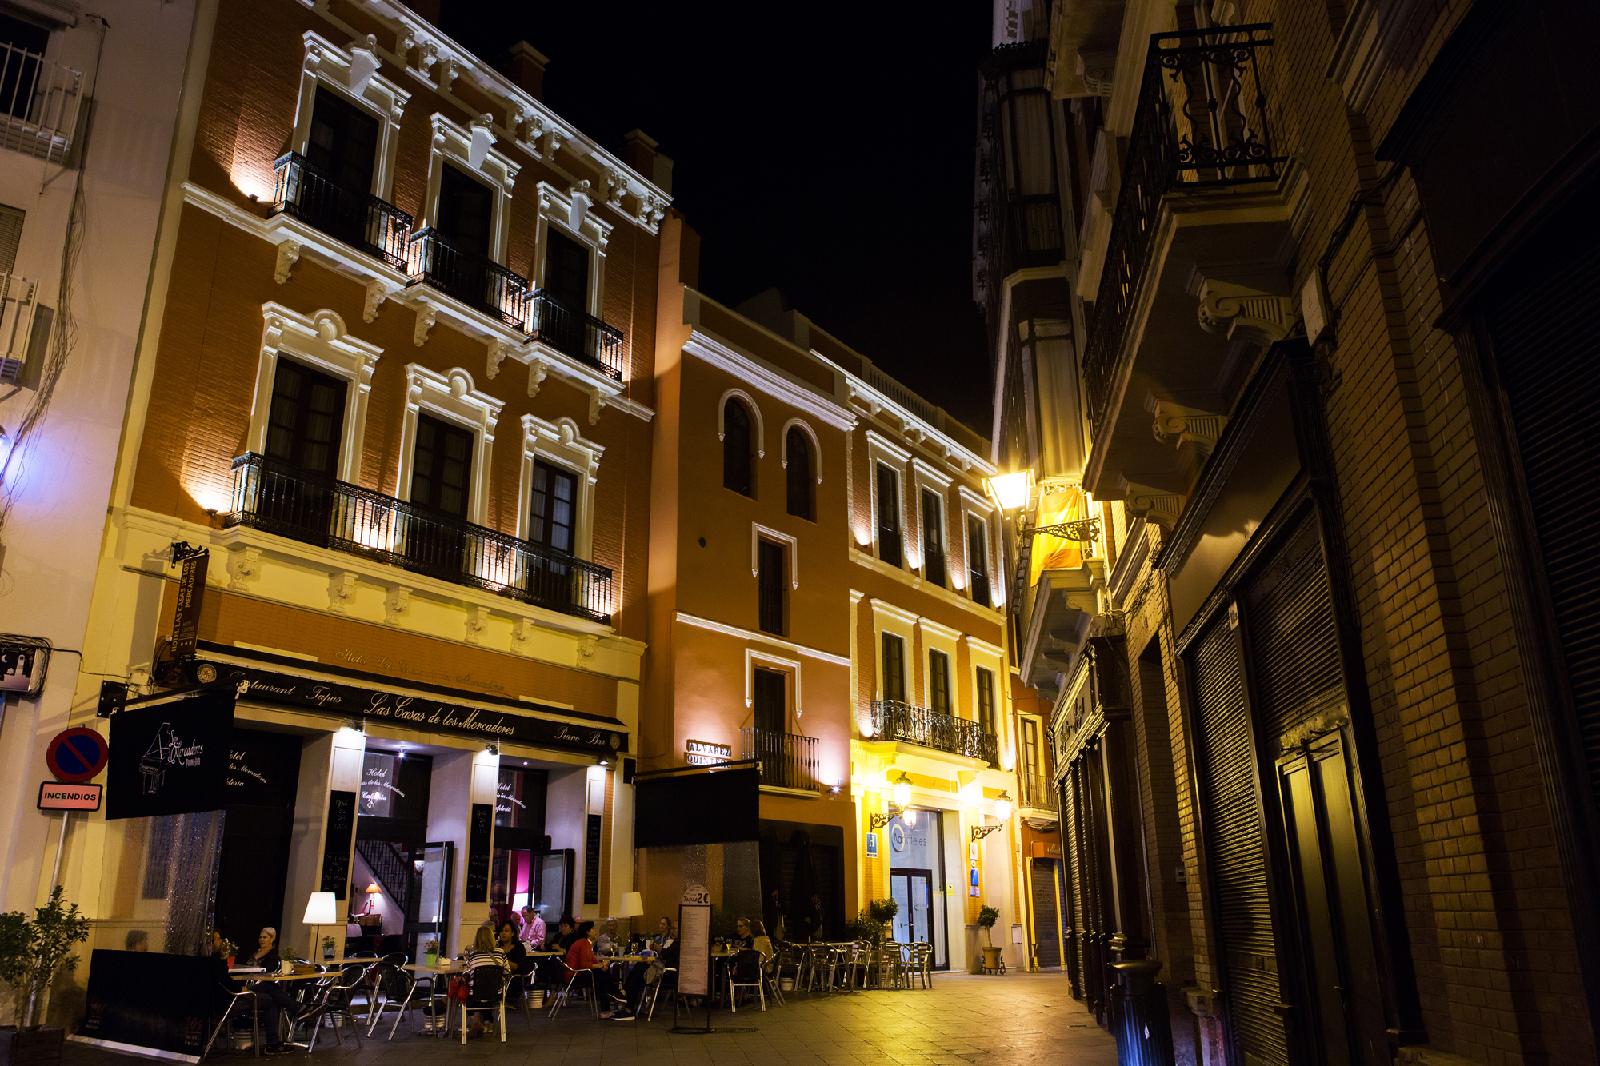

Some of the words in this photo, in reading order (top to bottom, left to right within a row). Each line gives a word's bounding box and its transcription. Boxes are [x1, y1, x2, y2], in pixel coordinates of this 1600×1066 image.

[305, 685, 343, 706] Tapas
[363, 693, 391, 716] Las
[394, 697, 425, 722] Casas
[427, 707, 443, 723] de
[442, 708, 459, 726] los
[458, 708, 515, 735] Mercaderes
[44, 792, 97, 801] INCENDIOS
